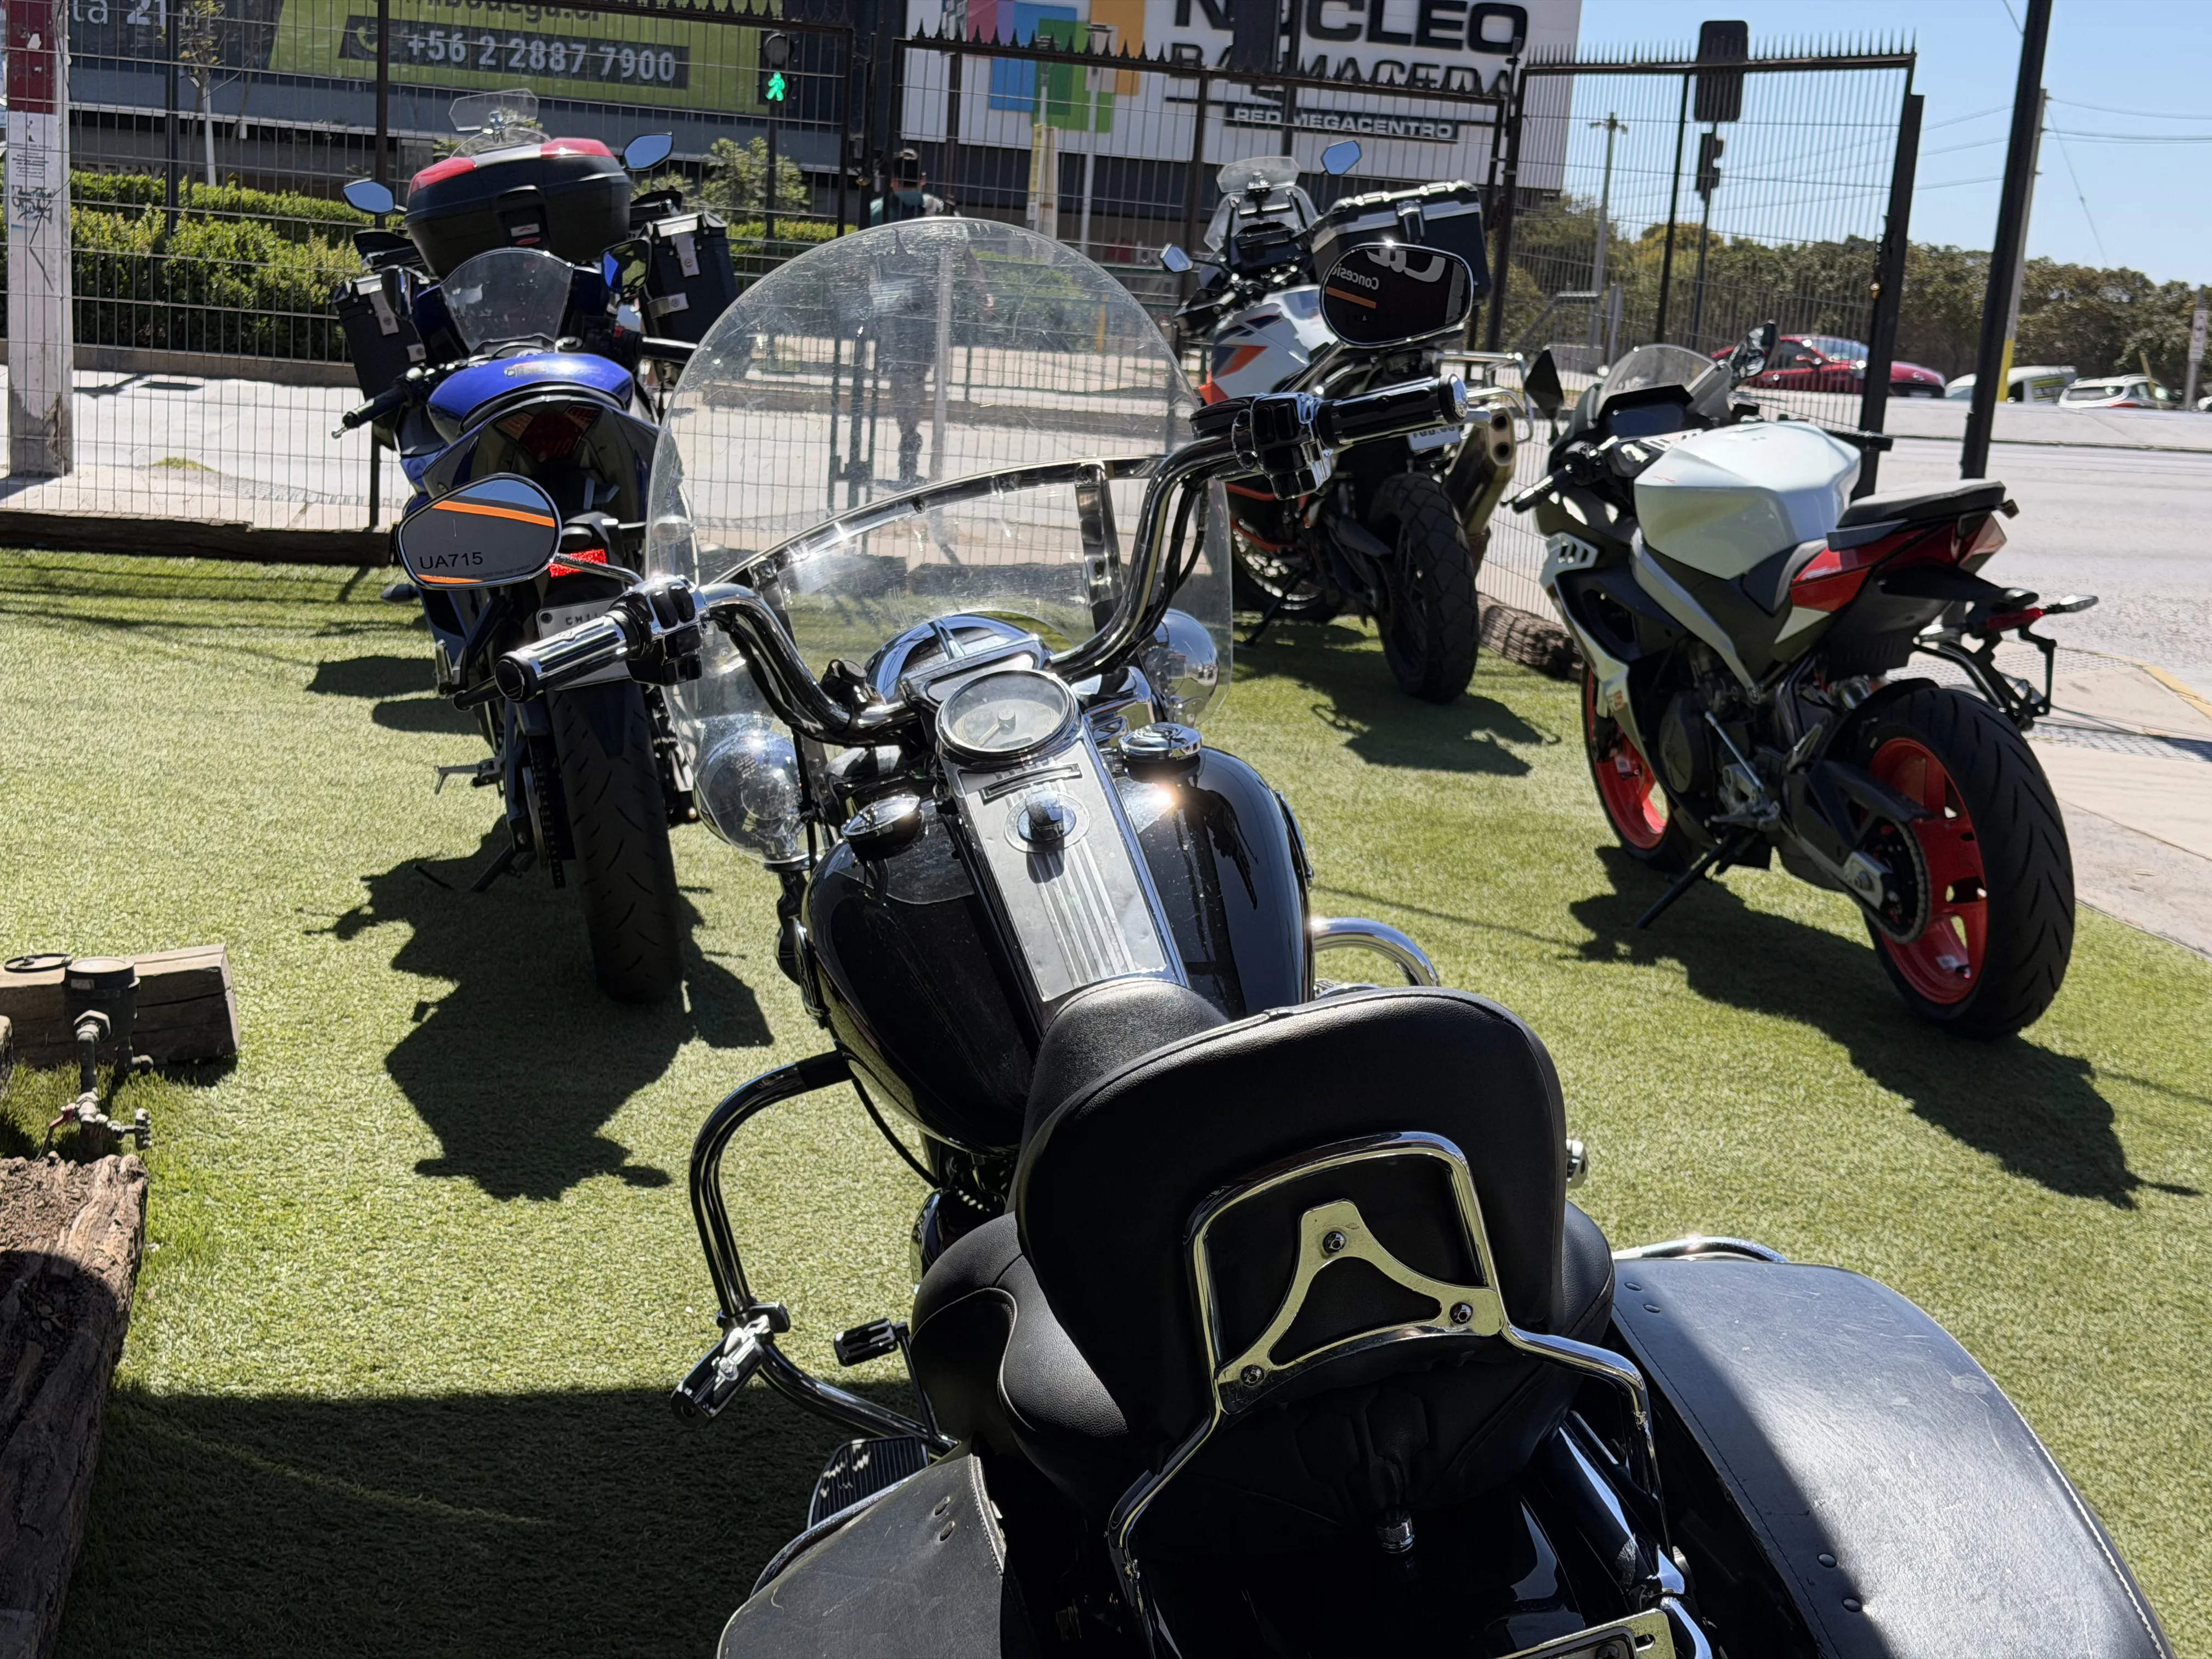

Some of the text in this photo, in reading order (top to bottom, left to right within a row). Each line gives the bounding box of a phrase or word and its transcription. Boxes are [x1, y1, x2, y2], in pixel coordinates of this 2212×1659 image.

[1174, 0, 1528, 54] NCLEO
[408, 31, 676, 82] +56 2 2887 7900
[1234, 109, 1454, 138] RED MEGACENTRO
[419, 551, 484, 571] UA715
